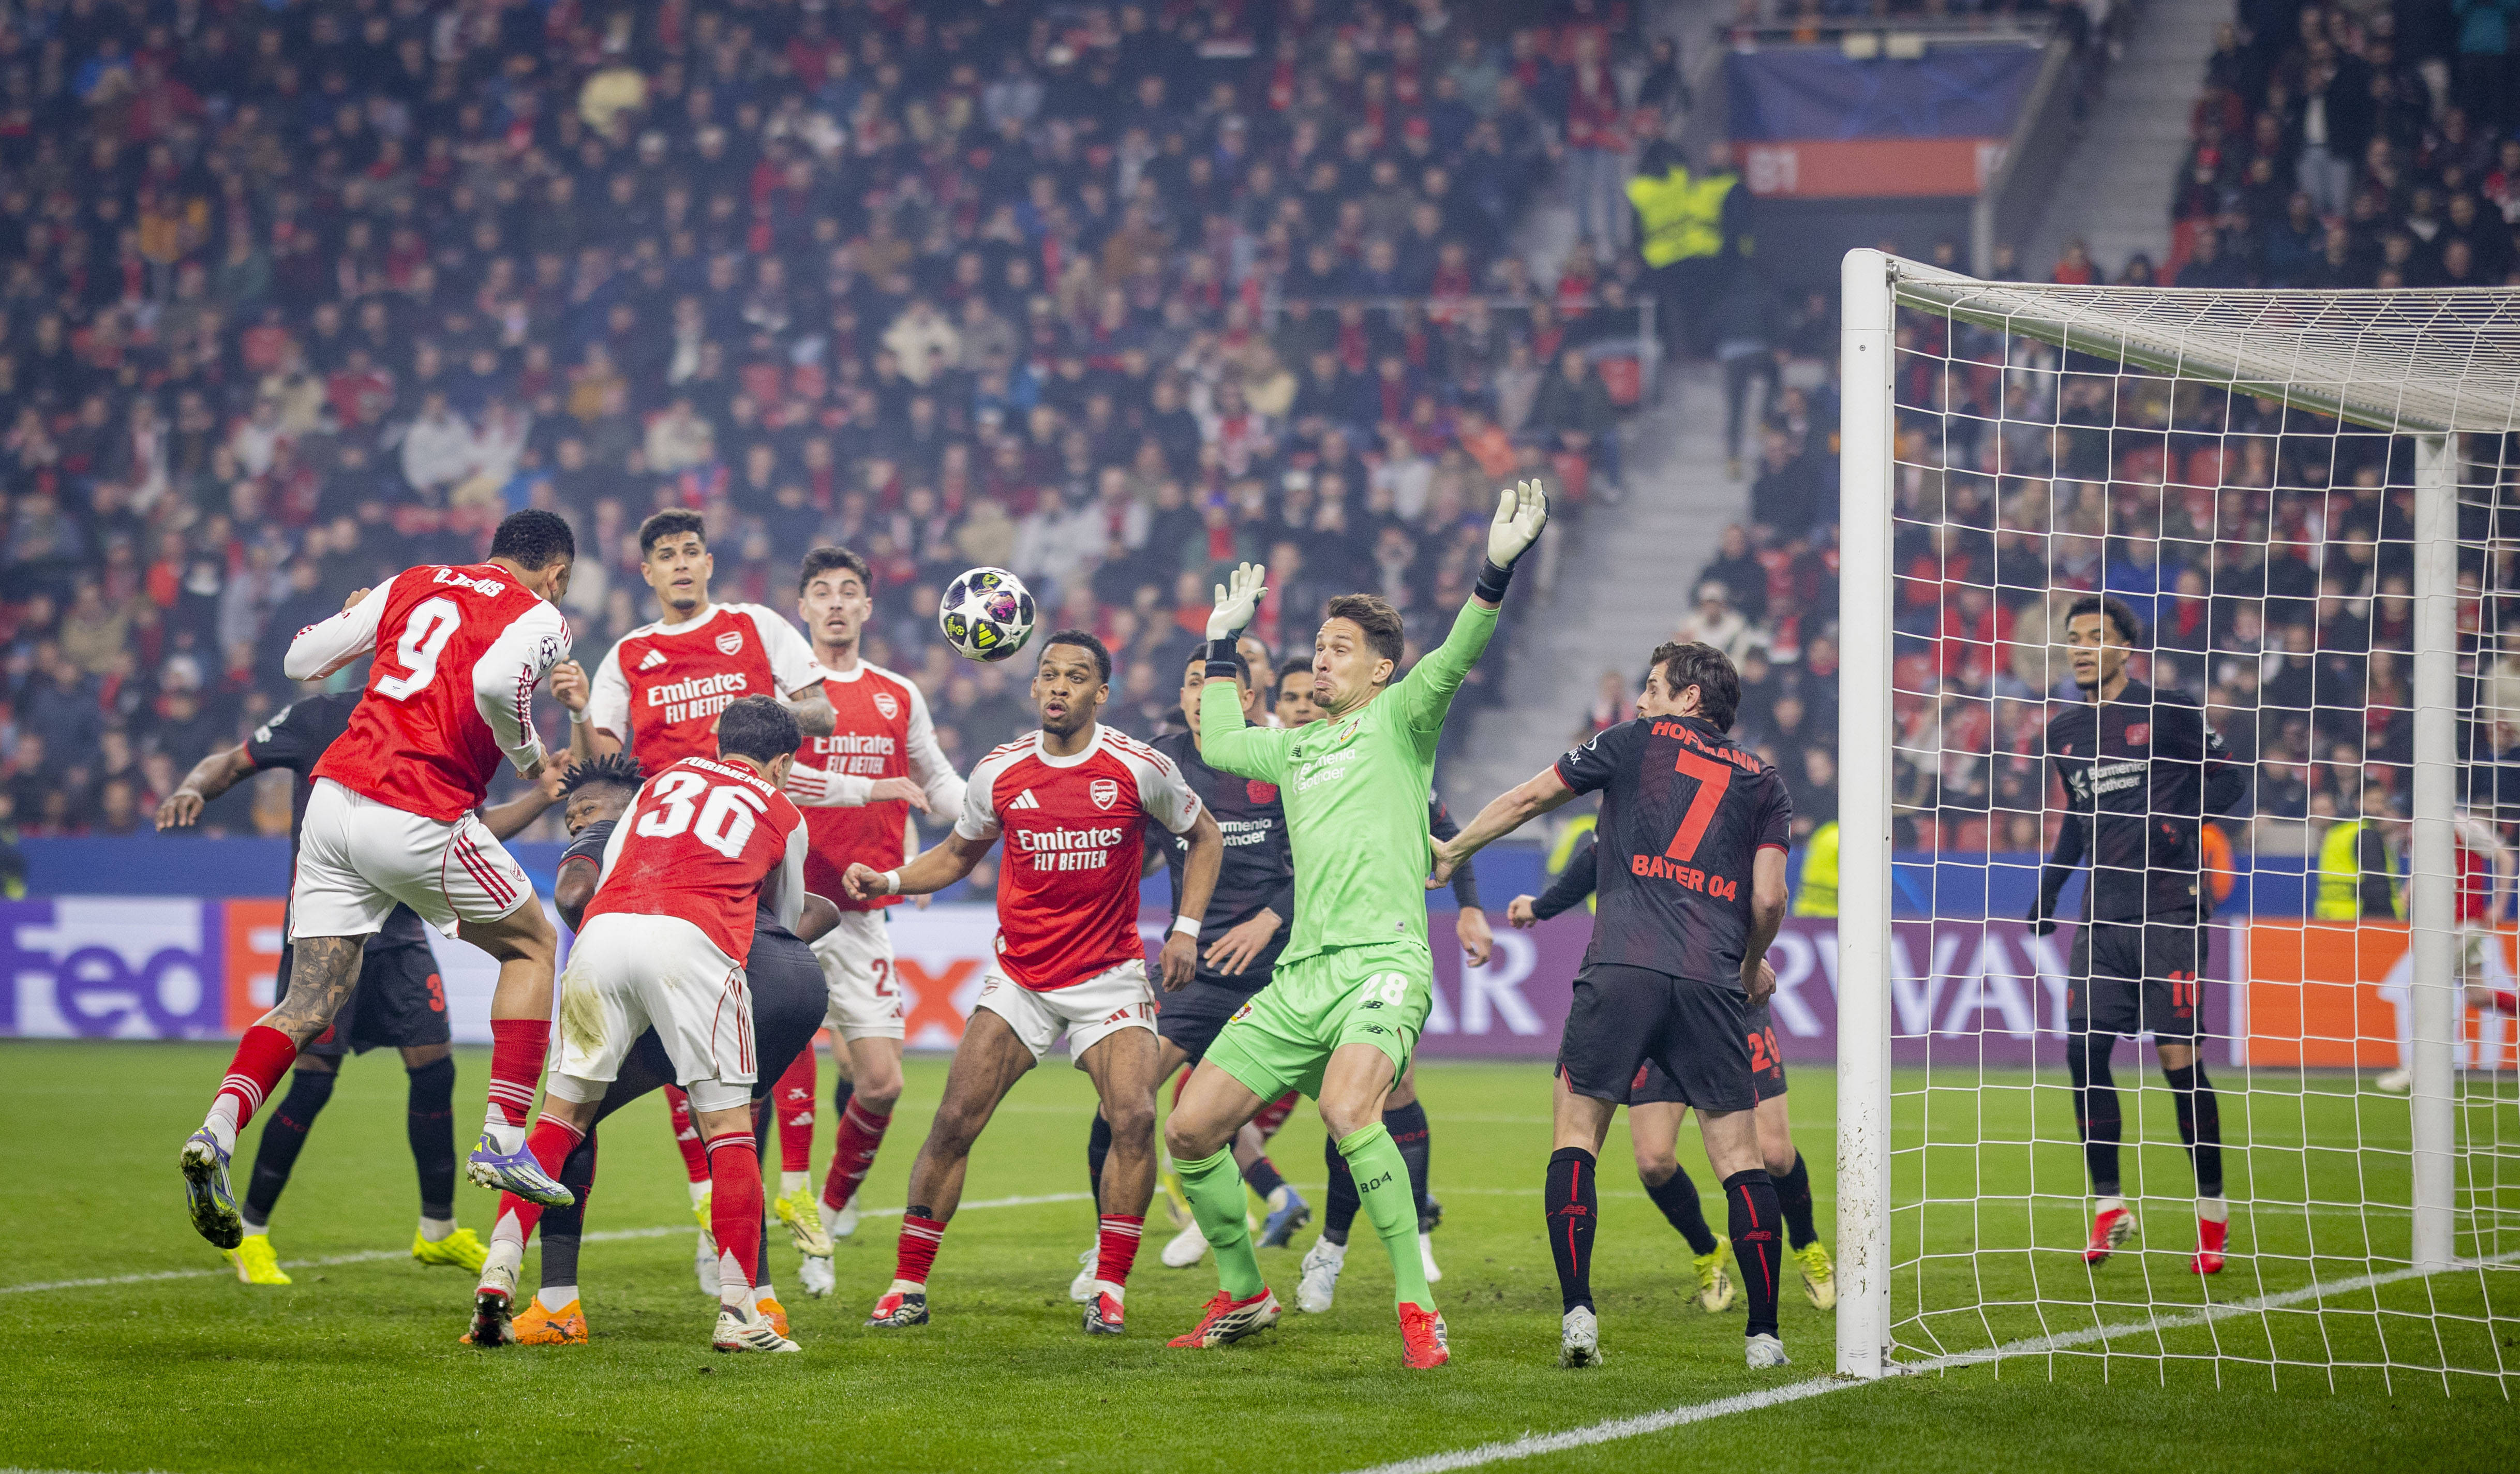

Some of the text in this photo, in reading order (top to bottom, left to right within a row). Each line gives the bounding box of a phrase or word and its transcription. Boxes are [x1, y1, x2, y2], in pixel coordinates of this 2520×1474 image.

[374, 596, 461, 702] 9
[648, 672, 748, 707] Emirates
[665, 702, 687, 724] FLY
[1651, 721, 1761, 775] HOFMANN
[2087, 761, 2148, 781] Barmenia
[2090, 775, 2142, 794] Gothaer
[635, 770, 768, 858] 36
[1674, 748, 1732, 862] 7
[1017, 826, 1123, 851] Emirates
[1217, 818, 1273, 833] armenia
[1222, 830, 1266, 847] othaer
[1034, 850, 1108, 871] FLY BETTER
[1631, 854, 1737, 902] BAYER 04
[1357, 972, 1409, 1006] 28
[2168, 970, 2200, 1007] 10
[1747, 1026, 1781, 1073] 20
[1360, 1171, 1393, 1194] B04
